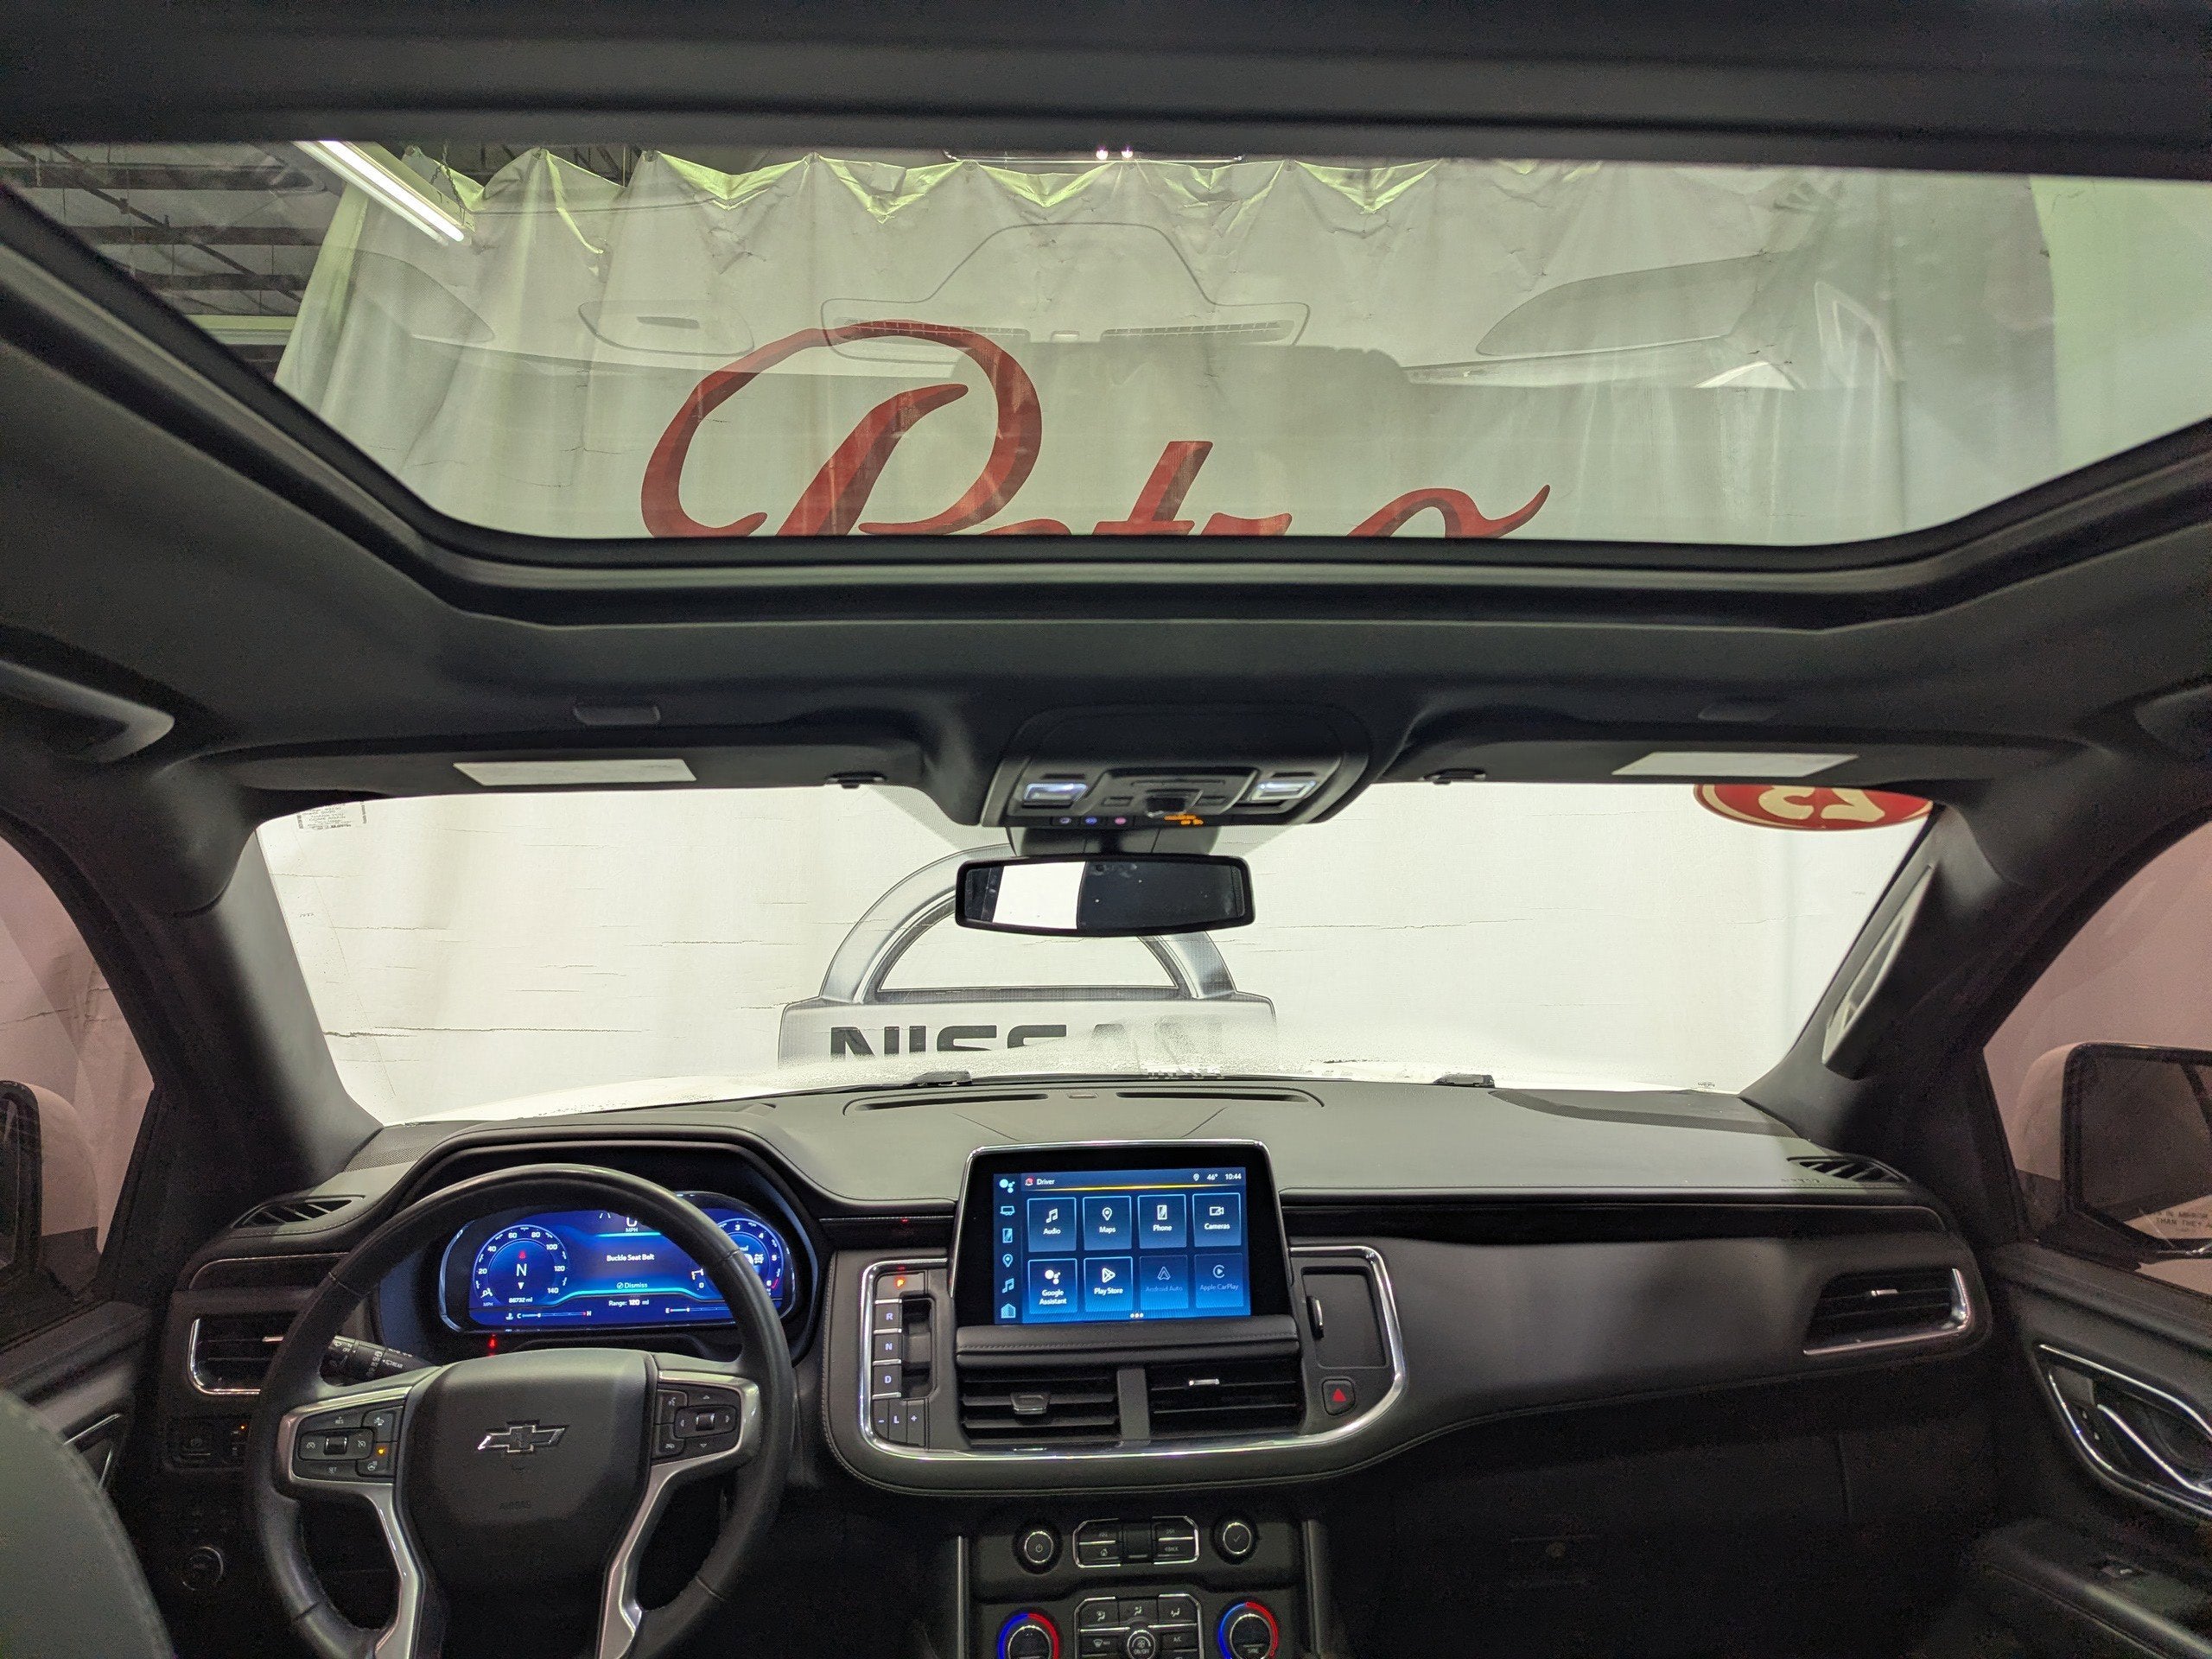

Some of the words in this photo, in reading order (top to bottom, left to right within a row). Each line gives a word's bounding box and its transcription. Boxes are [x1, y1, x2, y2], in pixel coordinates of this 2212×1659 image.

[1098, 1226, 1116, 1235] Maps
[1204, 1222, 1230, 1230] Cameras
[1043, 1227, 1062, 1236] Audio
[606, 1254, 627, 1262] Buckle
[642, 1253, 655, 1262] Belt
[516, 1262, 528, 1277] N
[1093, 1287, 1107, 1296] Play
[1199, 1283, 1216, 1292] Apple
[1217, 1282, 1239, 1292] CarPlay
[1041, 1288, 1065, 1298] Google
[885, 1342, 893, 1351] N
[893, 1415, 900, 1424] L
